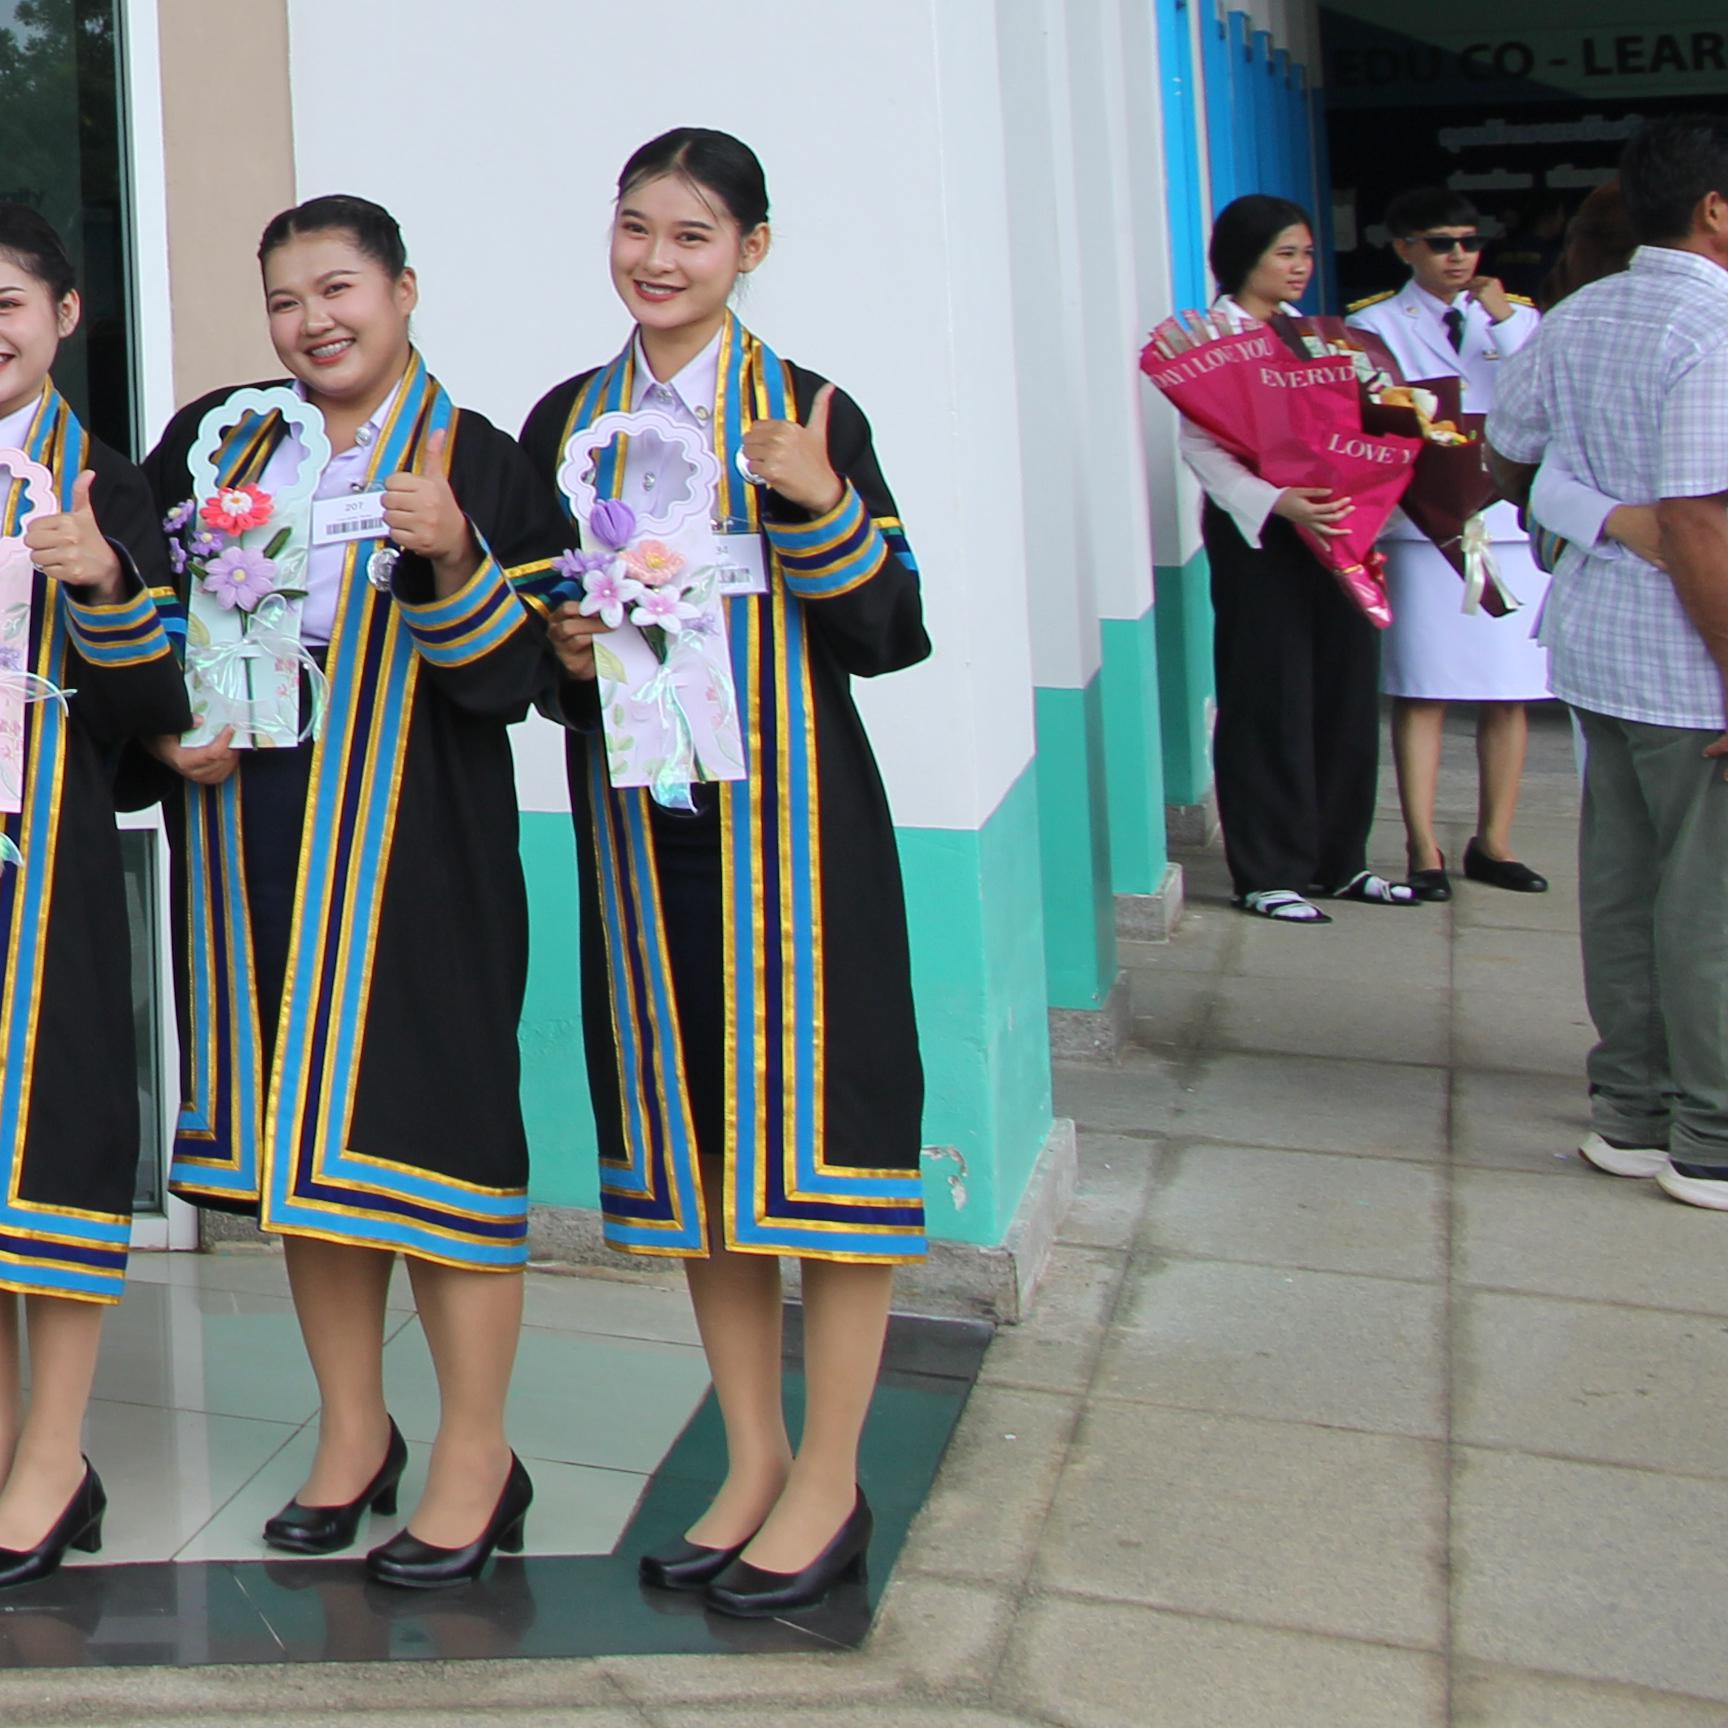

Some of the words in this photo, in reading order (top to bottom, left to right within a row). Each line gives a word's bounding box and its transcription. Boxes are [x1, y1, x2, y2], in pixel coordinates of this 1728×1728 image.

[1334, 46, 1443, 84] EDU
[1457, 40, 1535, 82] CO
[1191, 345, 1241, 373] LOVE
[1234, 337, 1275, 361] YOU
[1328, 432, 1396, 465] LOVE
